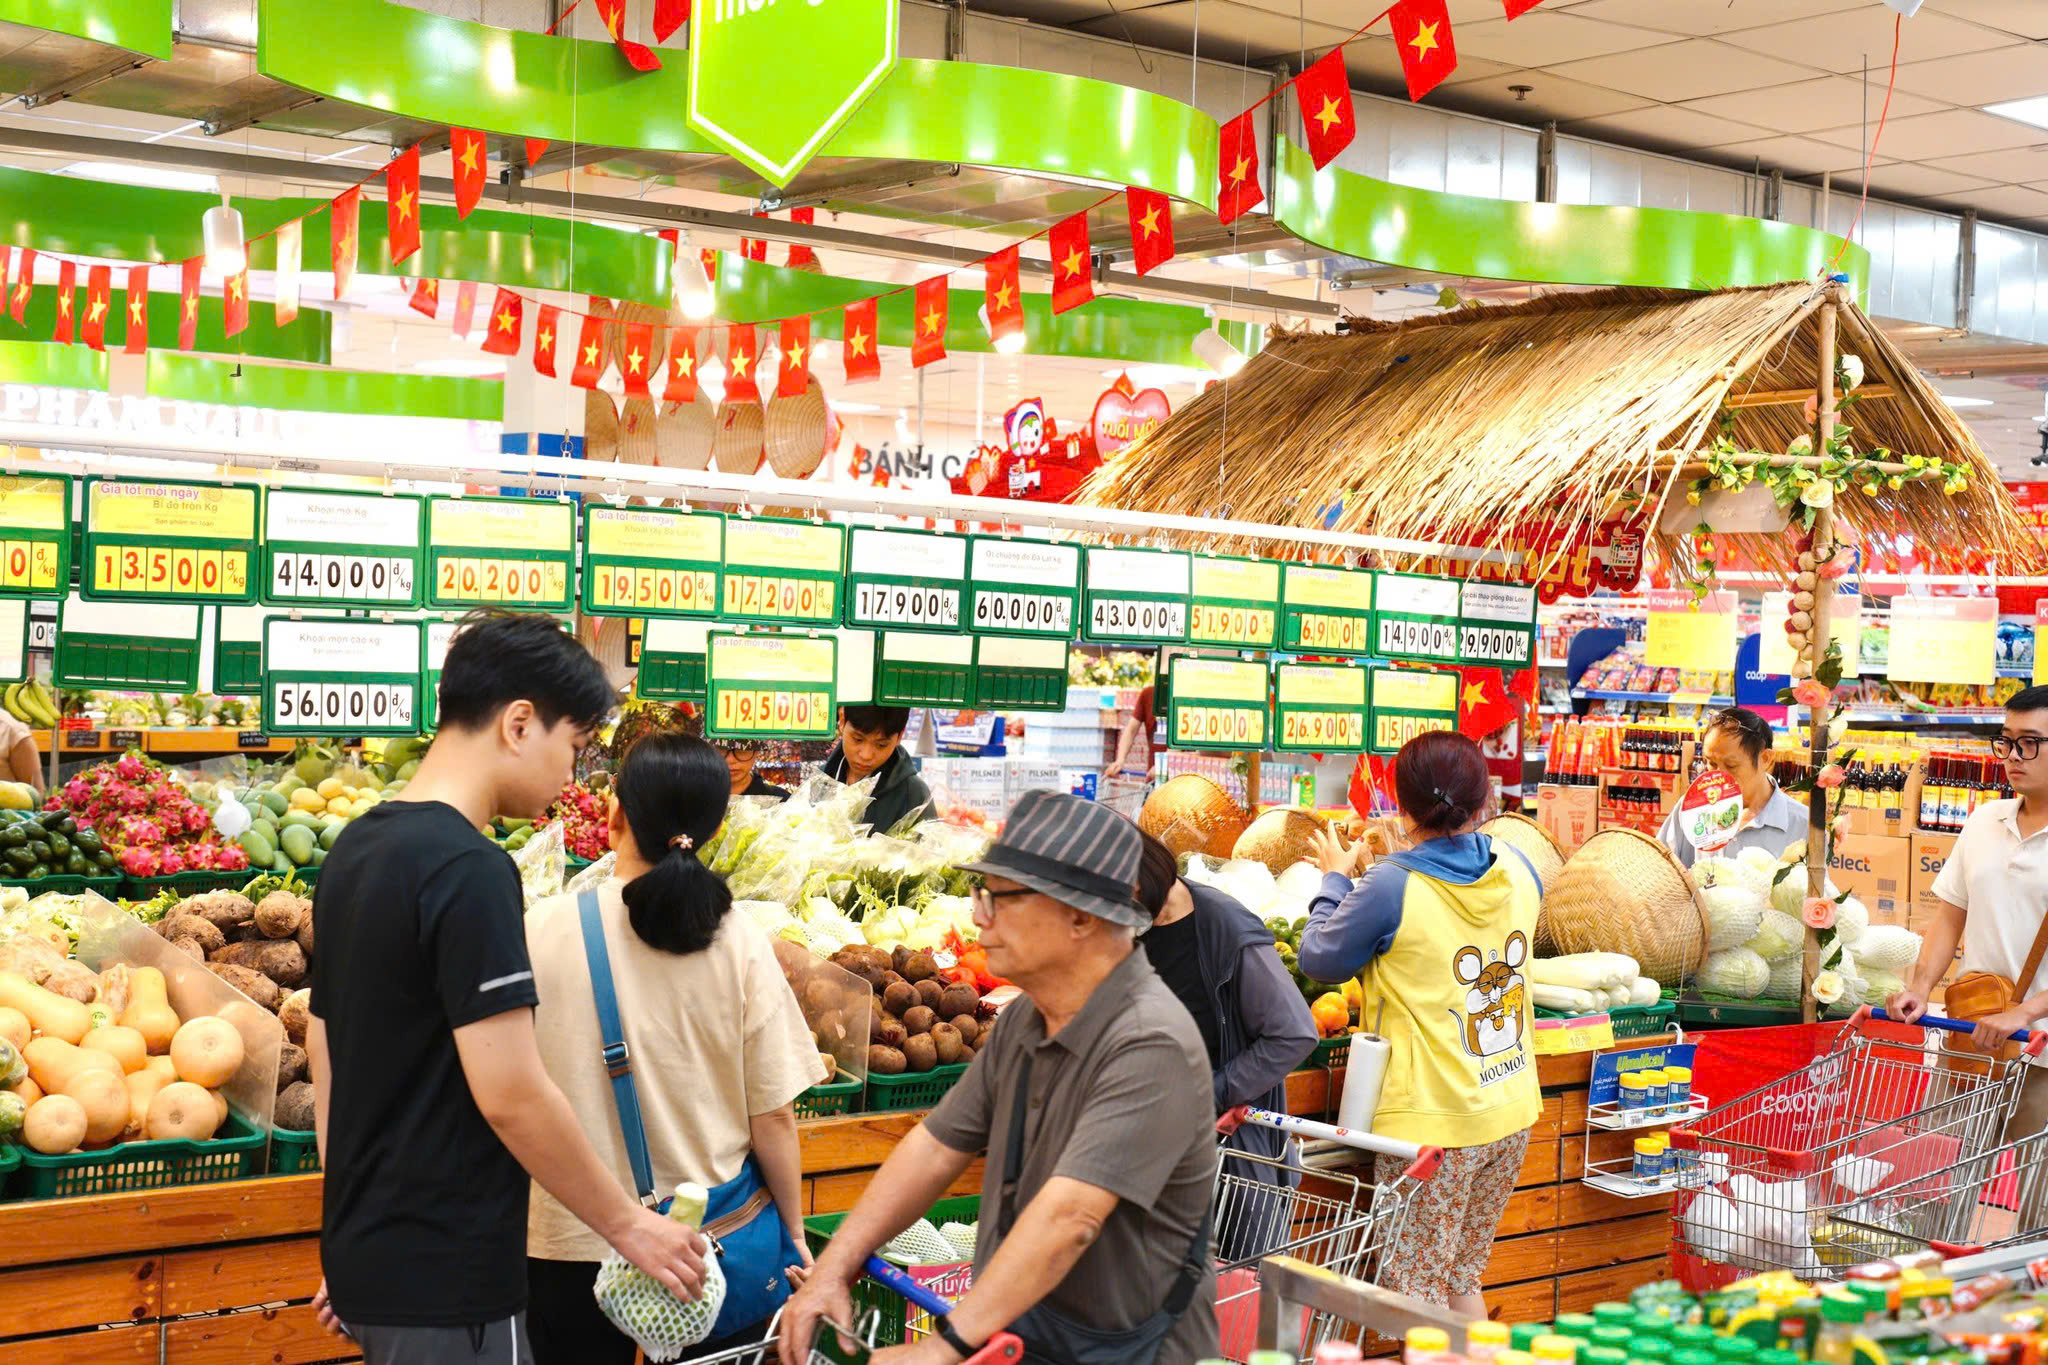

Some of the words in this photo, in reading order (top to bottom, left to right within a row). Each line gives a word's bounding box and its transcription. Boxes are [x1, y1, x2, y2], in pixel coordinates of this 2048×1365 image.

[100, 484, 122, 494] Giá
[124, 484, 141, 496] tốt
[171, 487, 200, 499] ngày
[104, 551, 218, 588] 13.500
[278, 559, 386, 589] 44.000
[443, 563, 541, 595] 20.200
[602, 574, 693, 602] 19.500
[730, 580, 812, 612] 17.200
[862, 591, 939, 617] 17.900
[977, 597, 1053, 624] 60.000
[1095, 604, 1168, 629] 43.000
[1191, 607, 1258, 636] 51.900
[1302, 619, 1351, 644] 6.900
[1383, 624, 1442, 649] 14.900
[280, 689, 387, 717] 56.000
[725, 694, 808, 724] 19.500
[1181, 712, 1247, 739] 52.000
[1287, 716, 1347, 738] 26.900
[970, 769, 1002, 777] PILSNER
[970, 799, 1001, 807] PILSNER
[1831, 854, 1871, 873] elect
[1479, 1052, 1527, 1085] MOUMOU
[1616, 1051, 1666, 1073] Umikai
